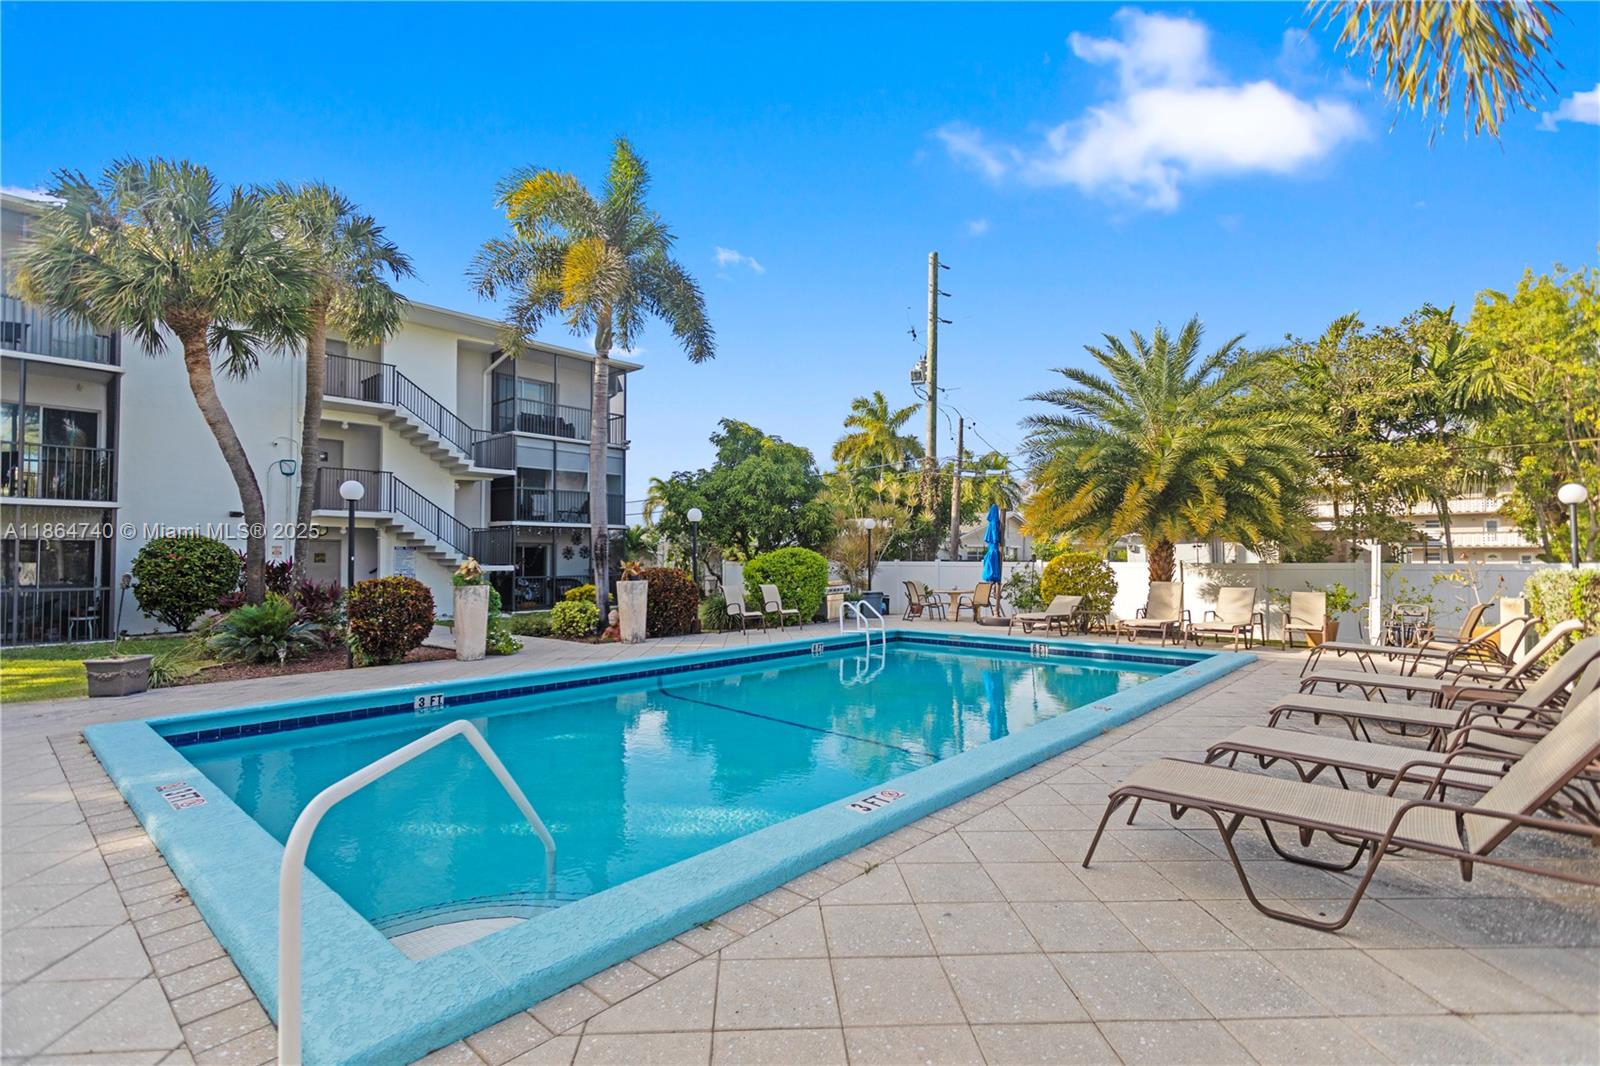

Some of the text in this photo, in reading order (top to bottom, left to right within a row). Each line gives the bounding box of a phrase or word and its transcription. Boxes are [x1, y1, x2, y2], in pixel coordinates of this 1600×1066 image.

[418, 694, 444, 707] 3 FT
[850, 803, 872, 812] 3
[861, 795, 890, 807] FT
